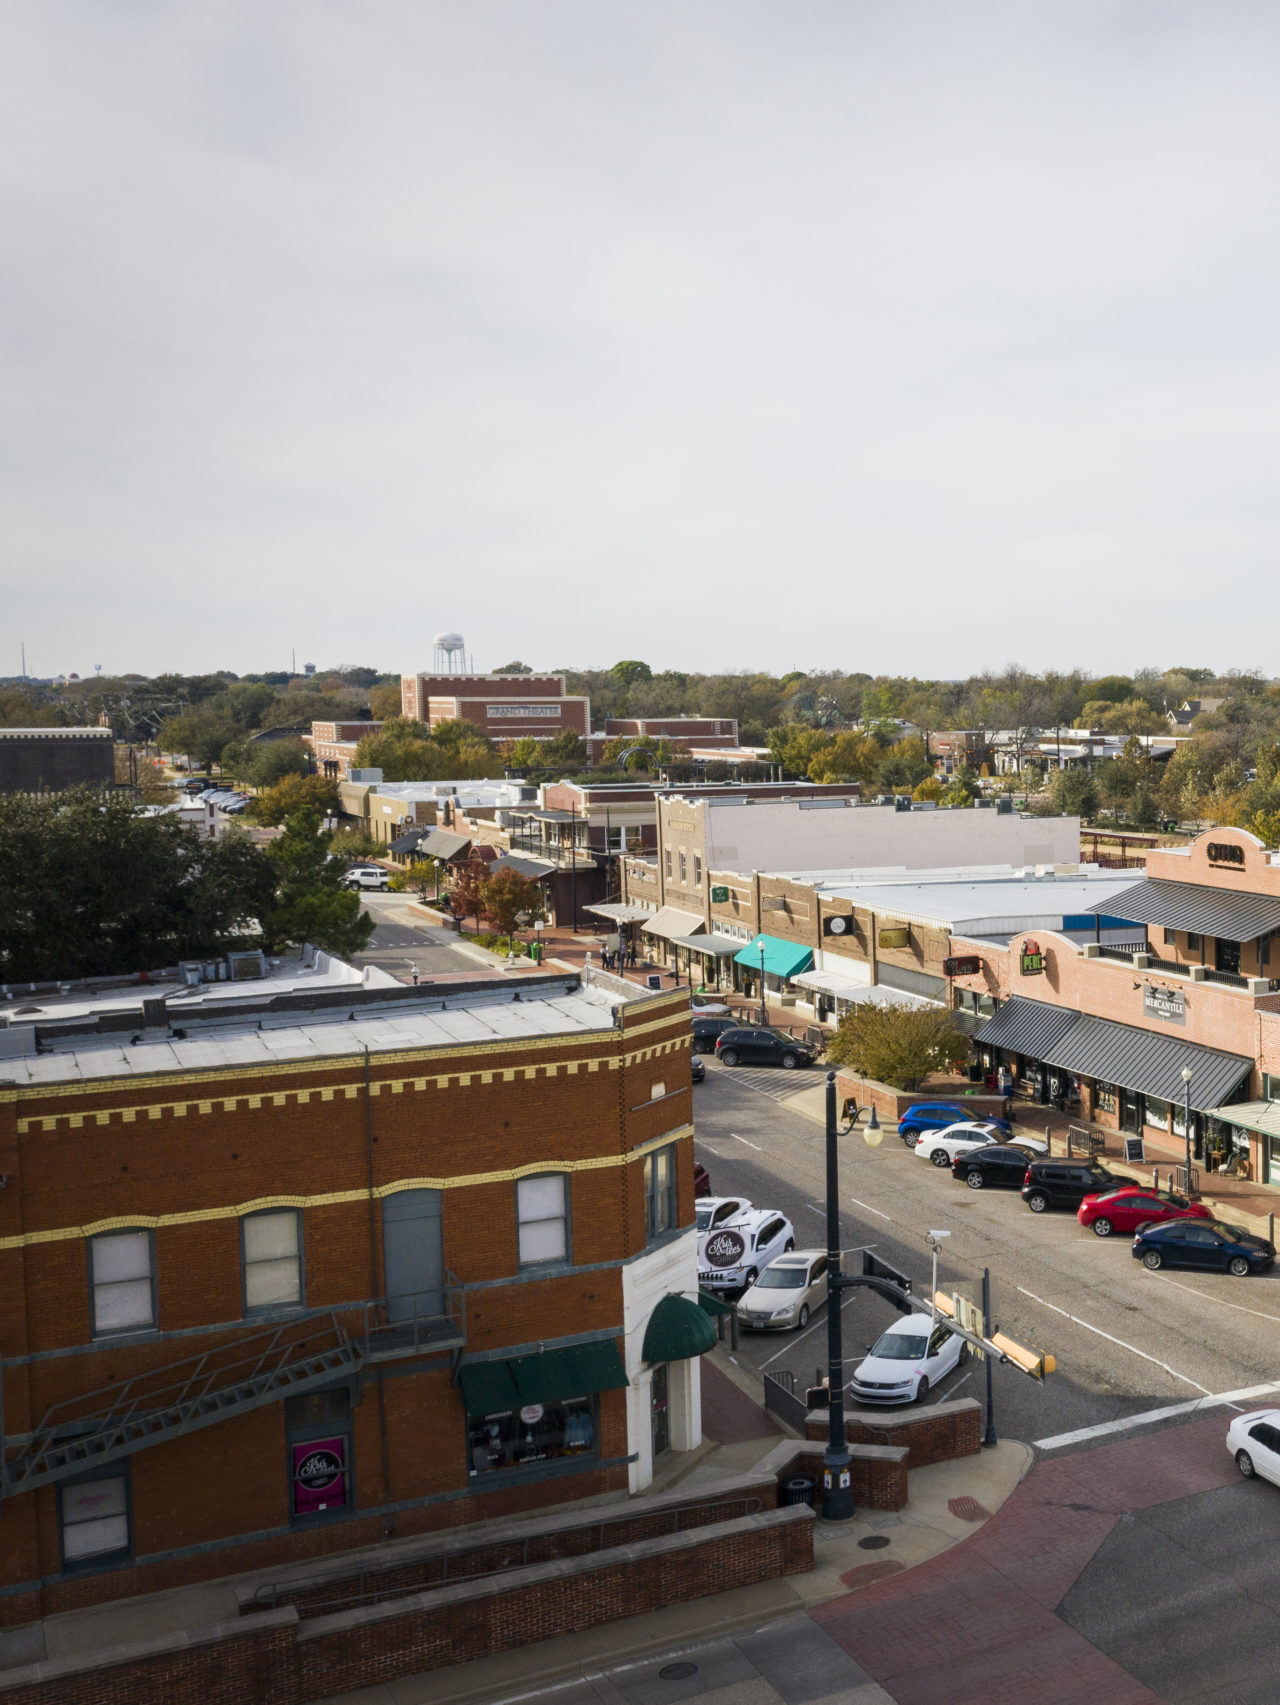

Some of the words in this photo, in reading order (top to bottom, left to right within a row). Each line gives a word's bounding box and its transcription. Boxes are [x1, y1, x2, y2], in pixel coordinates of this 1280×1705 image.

[488, 706, 520, 716] GRAND
[522, 706, 560, 716] THEATER
[1145, 997, 1184, 1014] MERCANTILE
